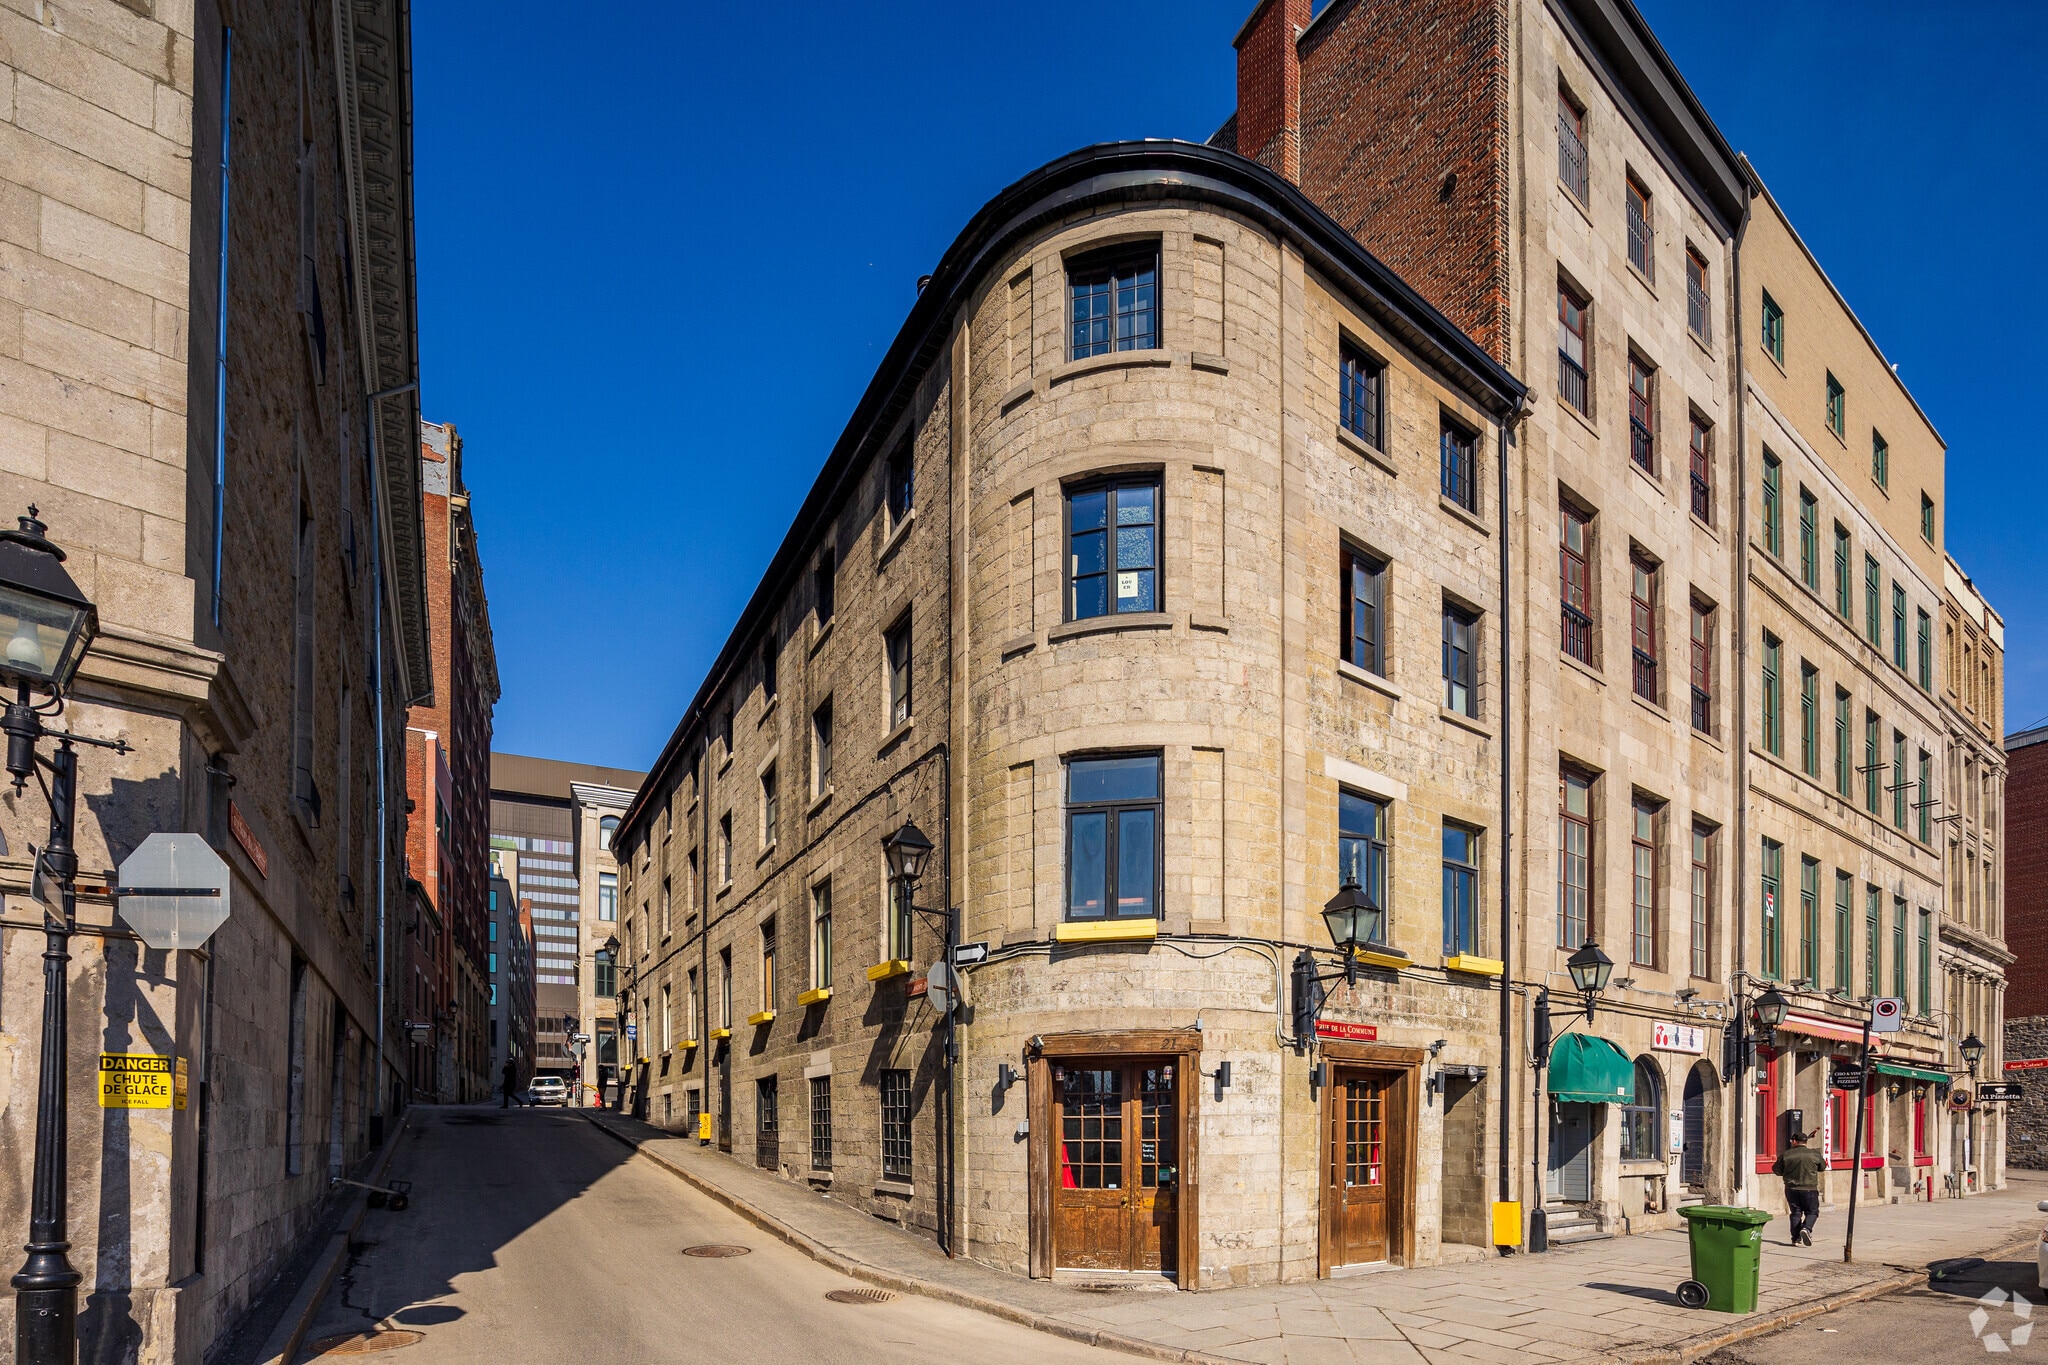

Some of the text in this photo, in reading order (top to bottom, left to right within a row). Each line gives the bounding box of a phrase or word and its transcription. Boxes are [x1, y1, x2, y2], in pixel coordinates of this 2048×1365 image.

[1160, 1037, 1176, 1050] 21
[102, 1058, 169, 1071] DANGER
[112, 1073, 158, 1085] CHUTE
[103, 1084, 121, 1095] DE
[124, 1085, 168, 1096] GLACE
[1670, 1155, 1678, 1166] 27
